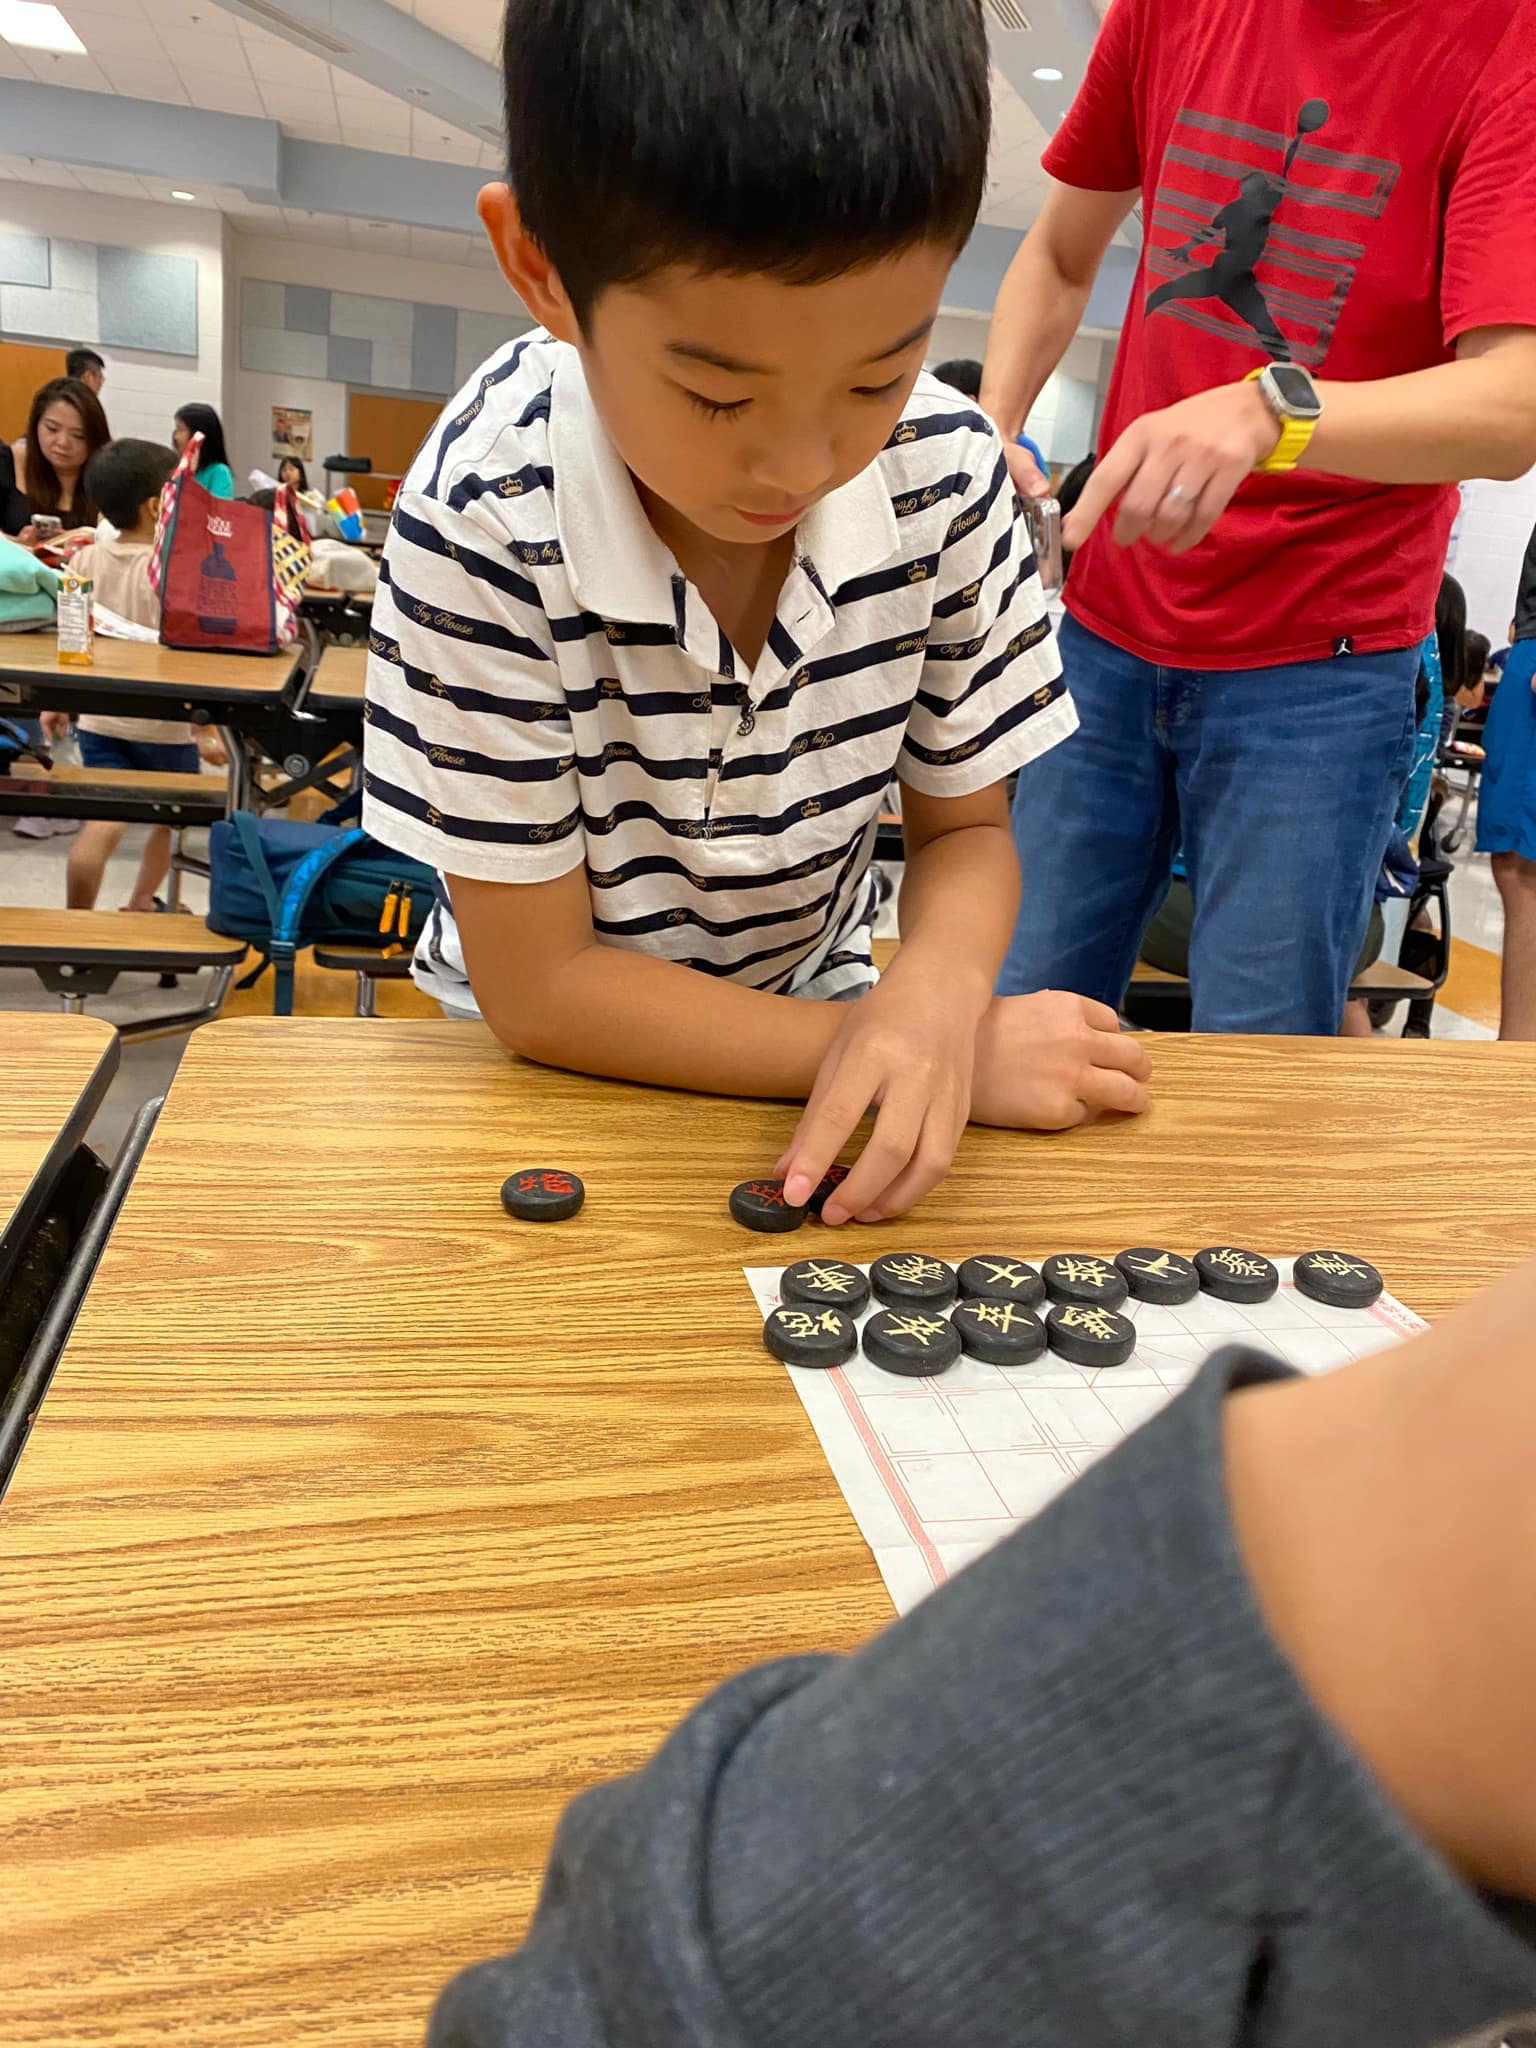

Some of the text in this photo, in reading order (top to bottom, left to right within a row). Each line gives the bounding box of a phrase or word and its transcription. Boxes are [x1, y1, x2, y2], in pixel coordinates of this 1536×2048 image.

[434, 611, 474, 635] House
[796, 1260, 855, 1292] 車
[974, 1259, 1034, 1290] 士
[1310, 1253, 1365, 1277] 車
[967, 1302, 1031, 1334] 卒
